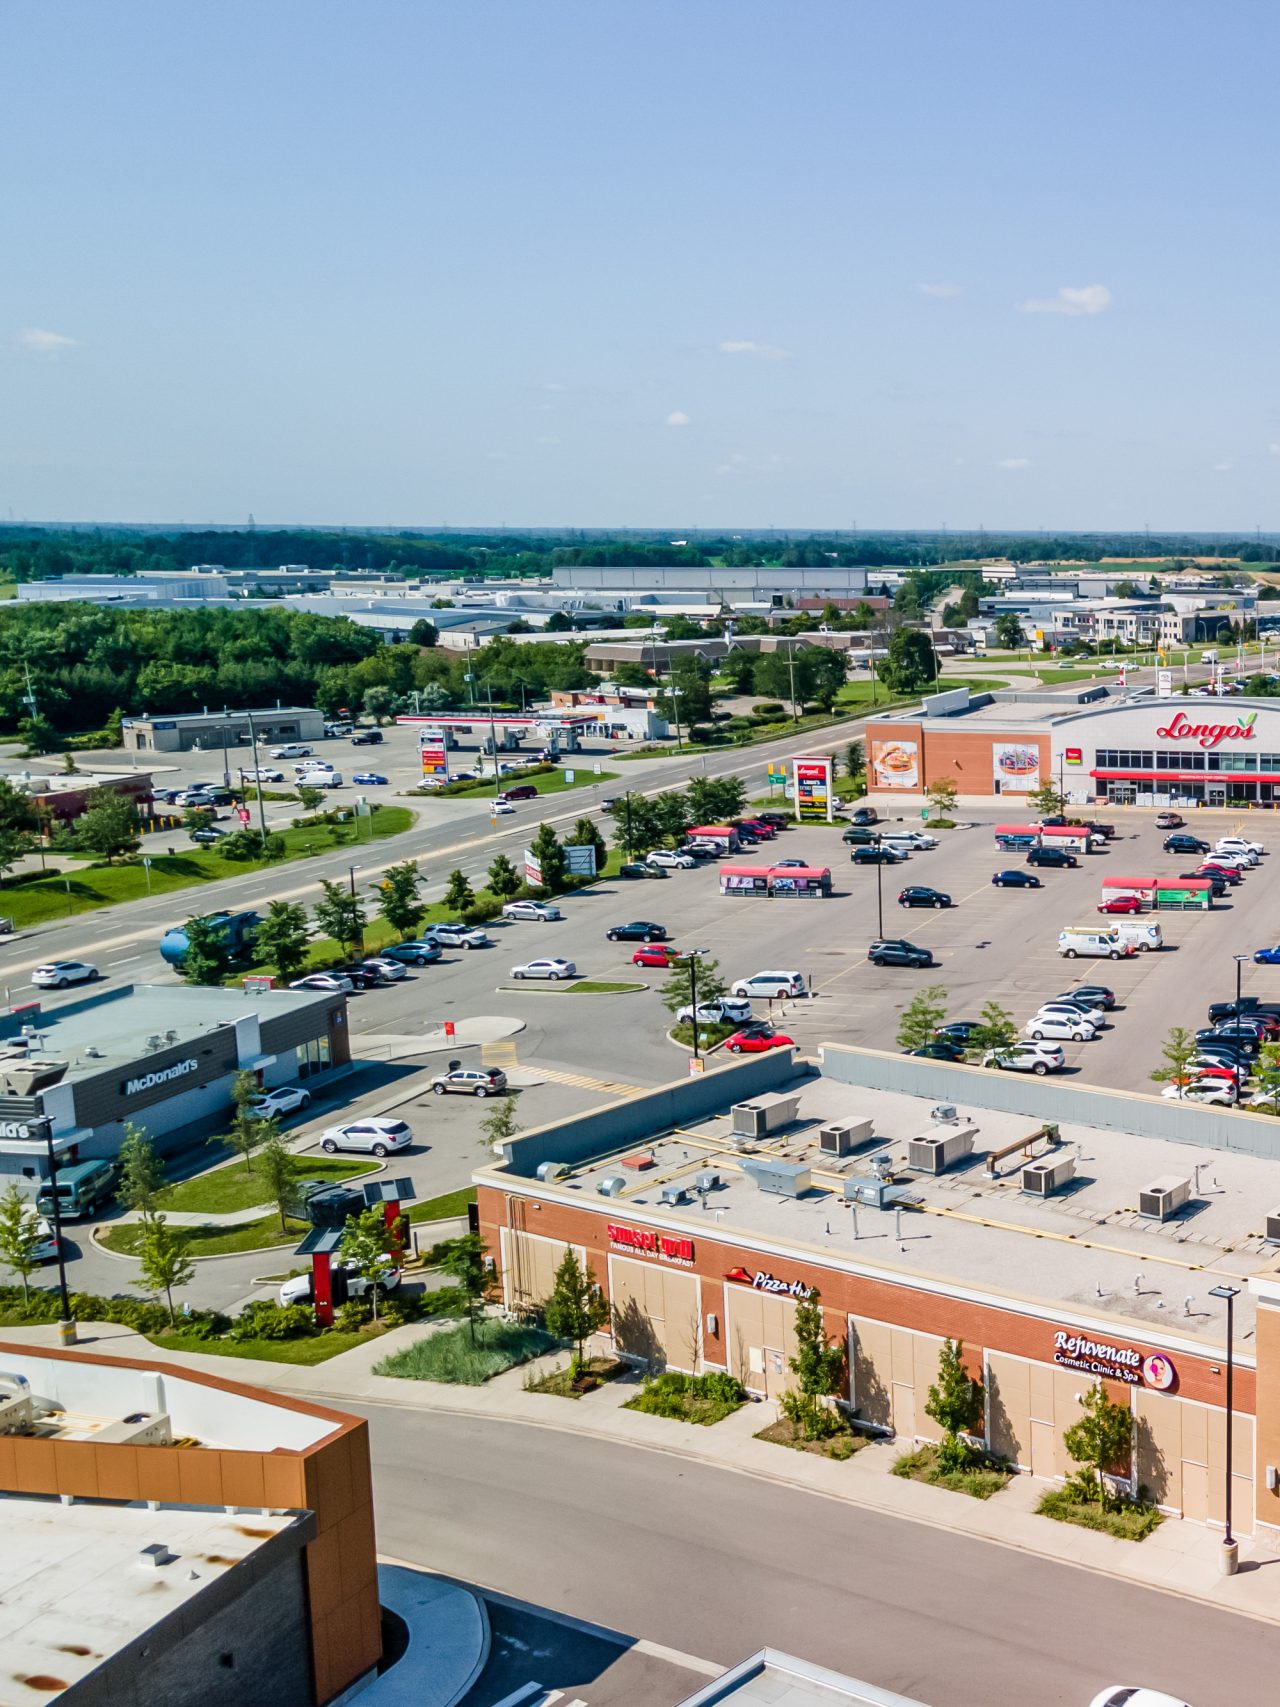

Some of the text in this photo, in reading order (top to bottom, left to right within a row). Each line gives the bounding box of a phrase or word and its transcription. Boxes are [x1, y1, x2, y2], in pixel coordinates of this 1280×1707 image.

[126, 1058, 198, 1096] McDonald's
[607, 1223, 693, 1260] sunset grill
[752, 1271, 788, 1292] Pizza
[1053, 1352, 1139, 1382] Cosmetic Clinic & Spa
[1054, 1331, 1140, 1367] Rejuvenate
